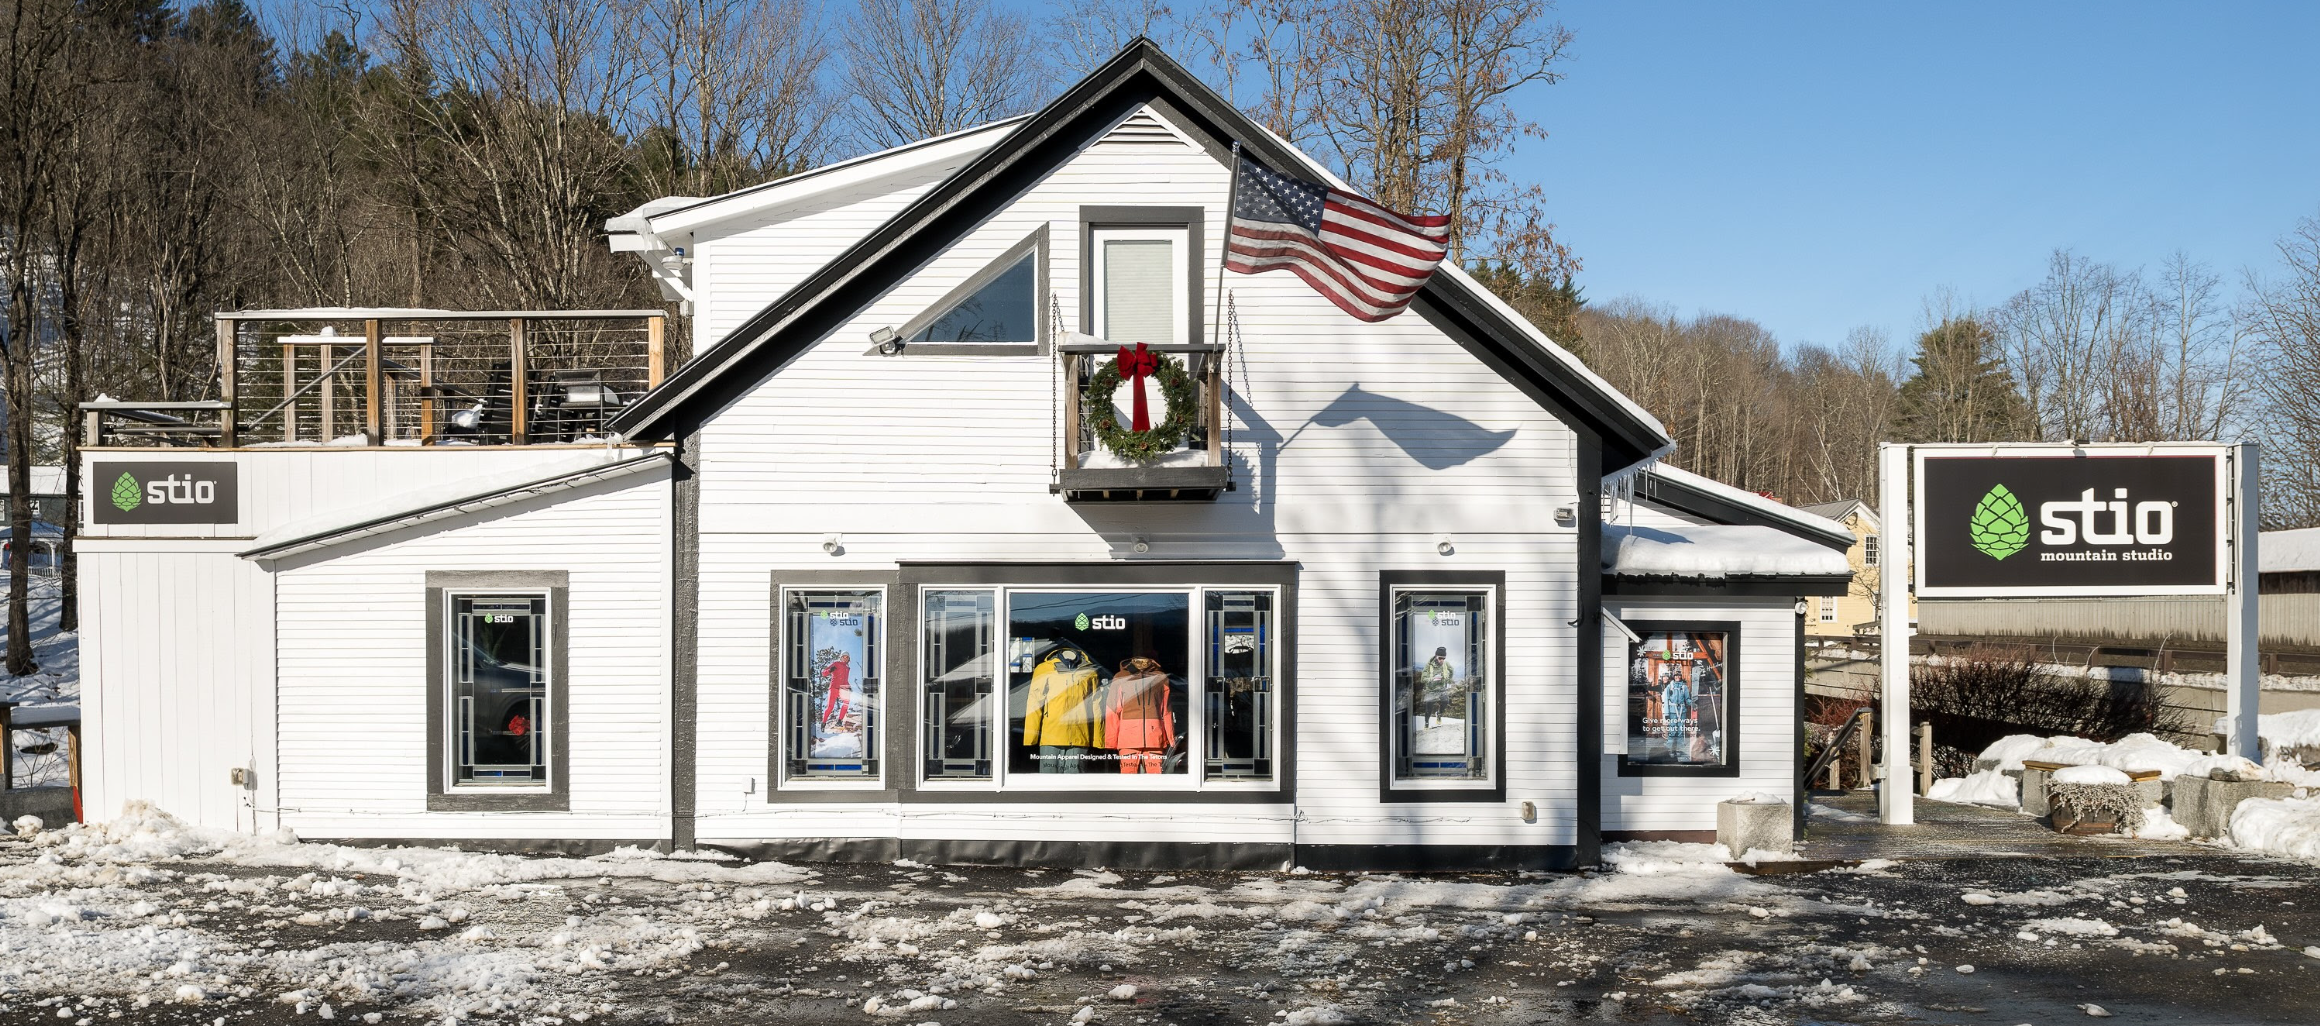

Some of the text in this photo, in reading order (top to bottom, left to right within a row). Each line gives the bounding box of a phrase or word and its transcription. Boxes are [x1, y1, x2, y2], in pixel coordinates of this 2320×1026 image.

[147, 473, 215, 504] stio
[2040, 487, 2174, 545] stio
[2040, 548, 2173, 561] mountain studio
[494, 614, 514, 623] stio
[830, 611, 848, 619] stio
[1092, 614, 1126, 630] stio
[1057, 753, 1080, 761] Apparel
[1080, 753, 1107, 761] Designed
